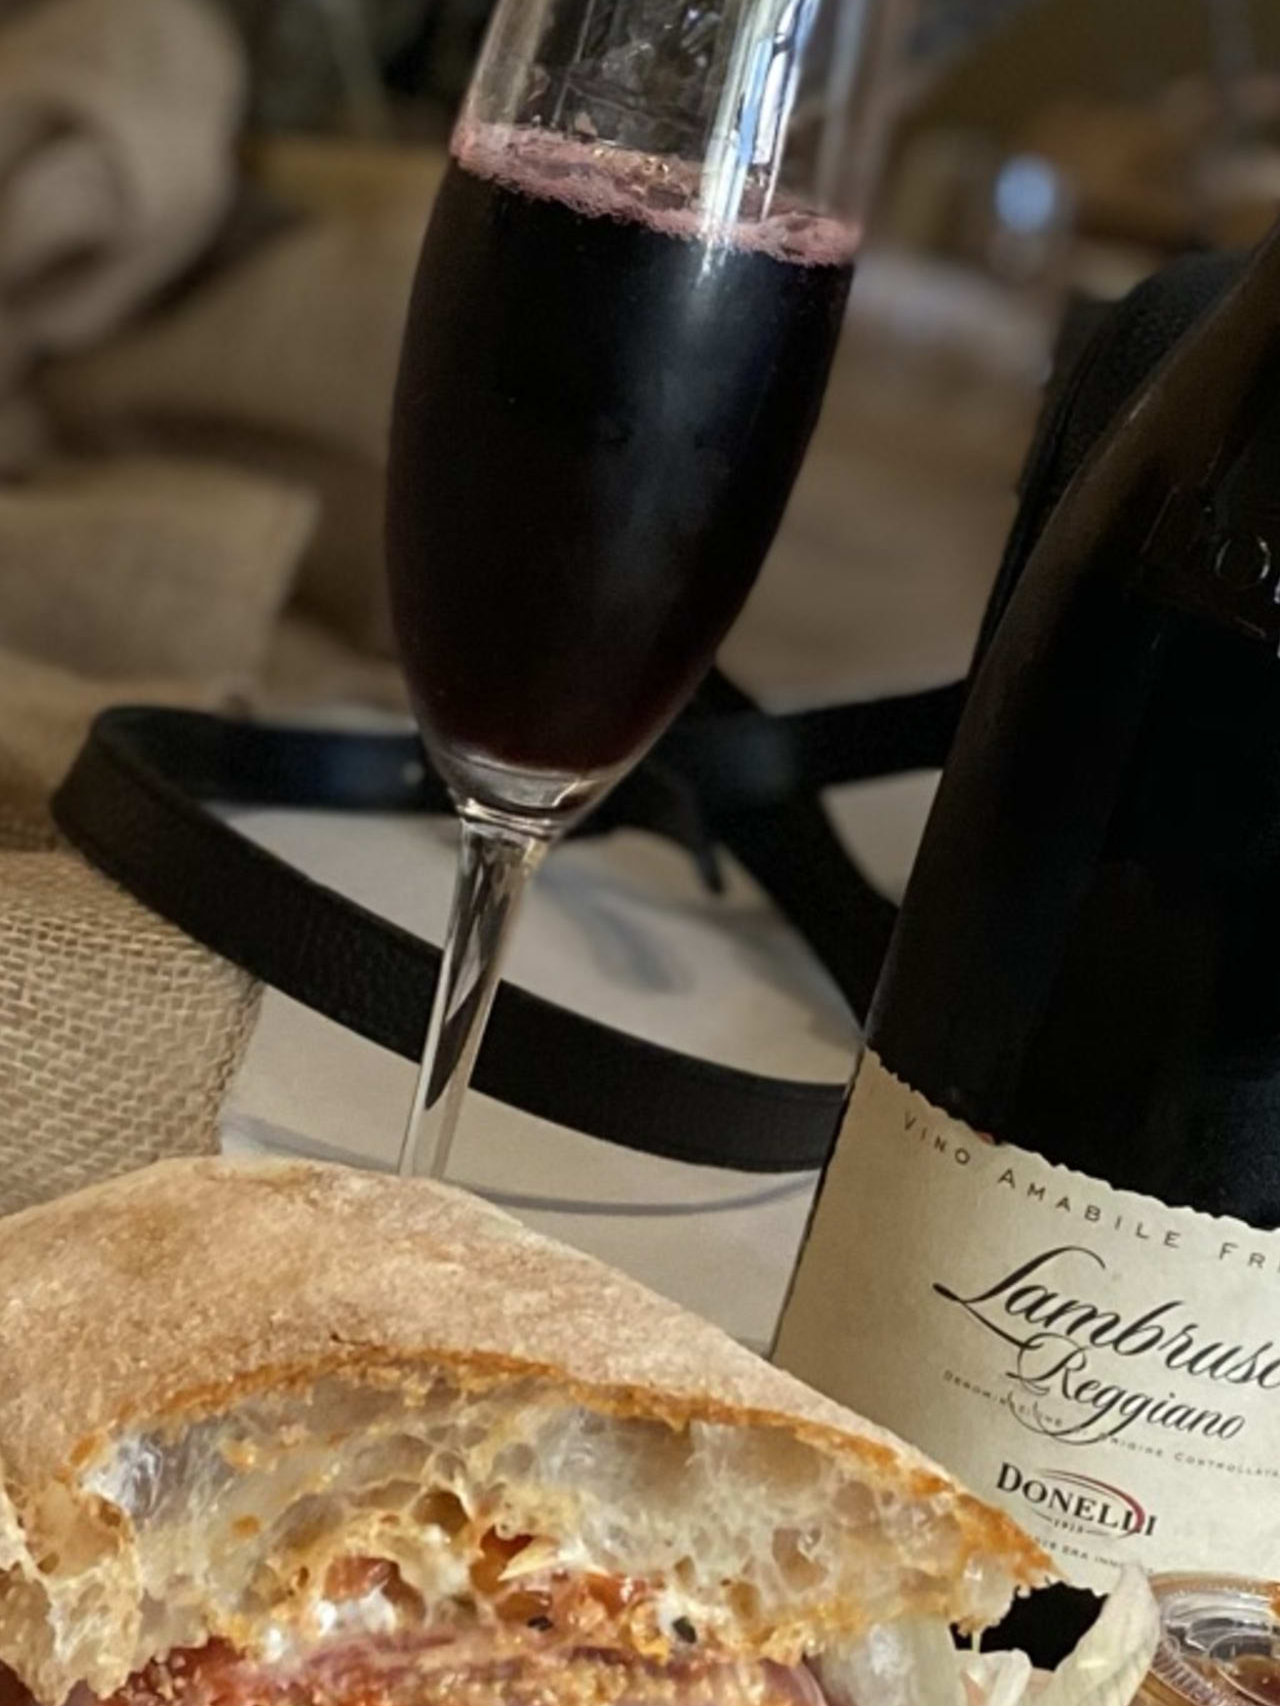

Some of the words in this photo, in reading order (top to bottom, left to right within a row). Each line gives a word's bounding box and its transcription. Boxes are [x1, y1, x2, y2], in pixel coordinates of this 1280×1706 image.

[902, 1110, 971, 1166] VINO
[996, 1167, 1181, 1249] AMABILE
[1005, 1330, 1247, 1446] Reggiano
